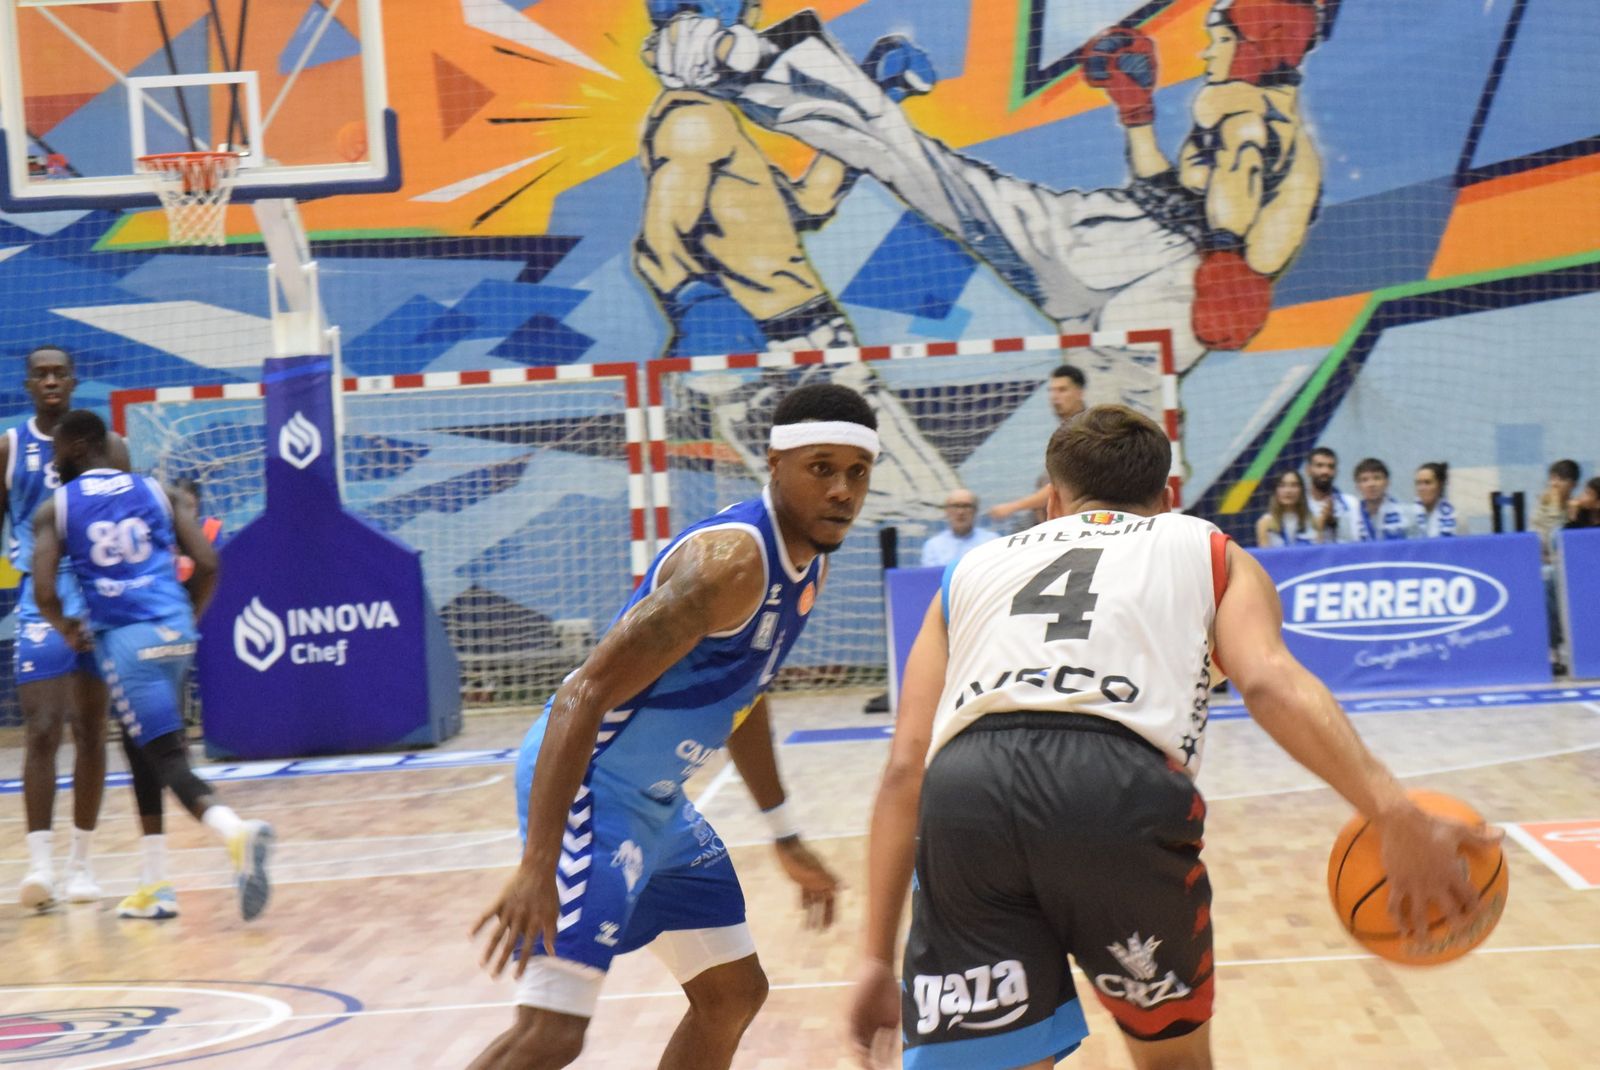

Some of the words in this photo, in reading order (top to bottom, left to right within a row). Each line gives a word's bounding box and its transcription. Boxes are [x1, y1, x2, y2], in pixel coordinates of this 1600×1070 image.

[287, 600, 400, 637] INNOVA
[1010, 547, 1105, 643] 4
[1292, 576, 1476, 623] FERRERO
[290, 638, 349, 667] Chef
[912, 959, 1030, 1036] gaza
